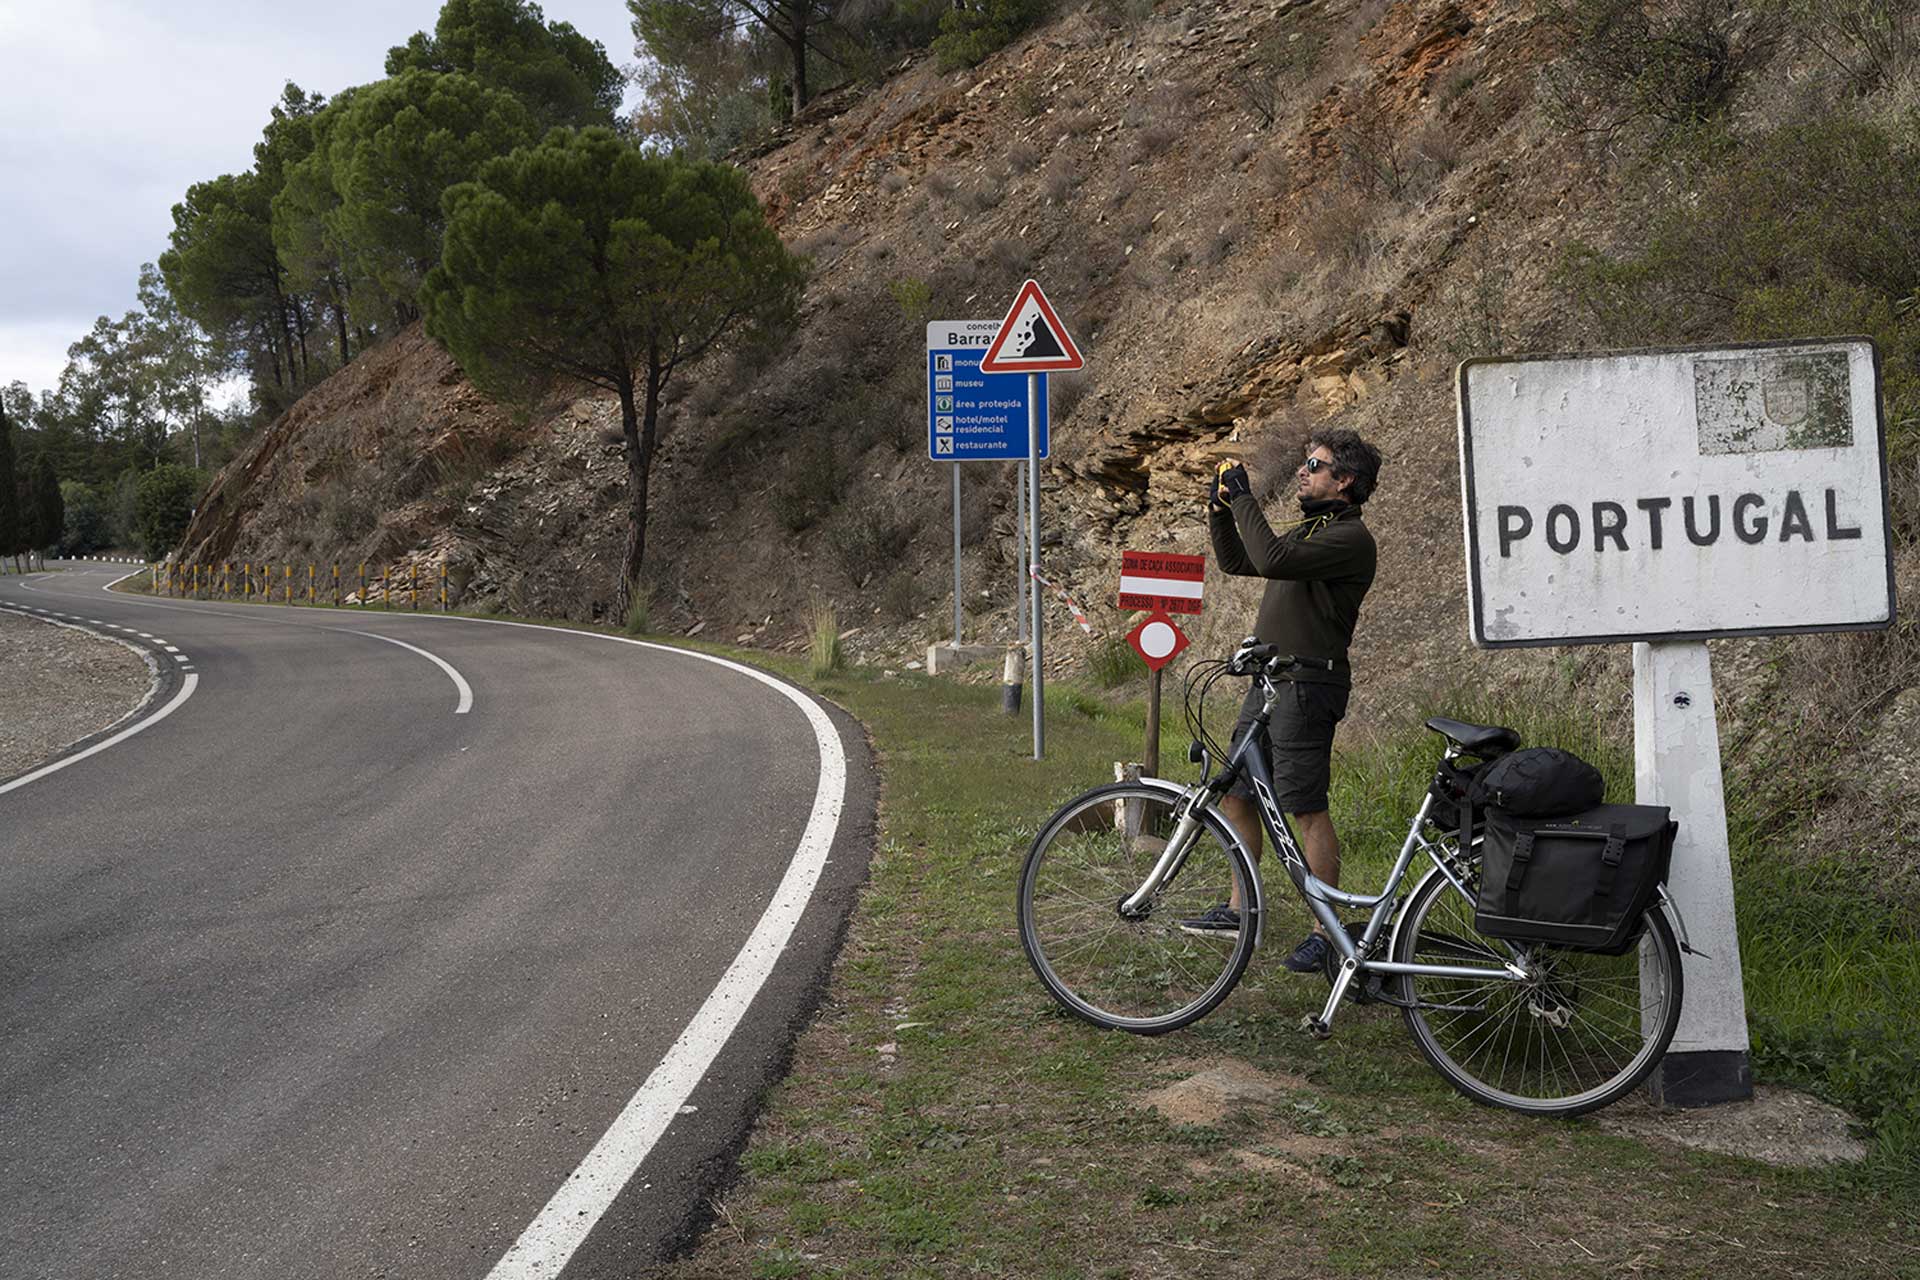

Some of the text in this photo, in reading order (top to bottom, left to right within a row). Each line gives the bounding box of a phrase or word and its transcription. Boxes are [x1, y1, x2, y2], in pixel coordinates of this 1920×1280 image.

[948, 332, 995, 345] Barra
[955, 399, 1022, 409] área protegida
[955, 416, 1008, 424] hotel/motel
[955, 425, 1004, 433] residencial
[955, 441, 1008, 449] restaurante
[1498, 488, 1862, 557] PORTUGAL
